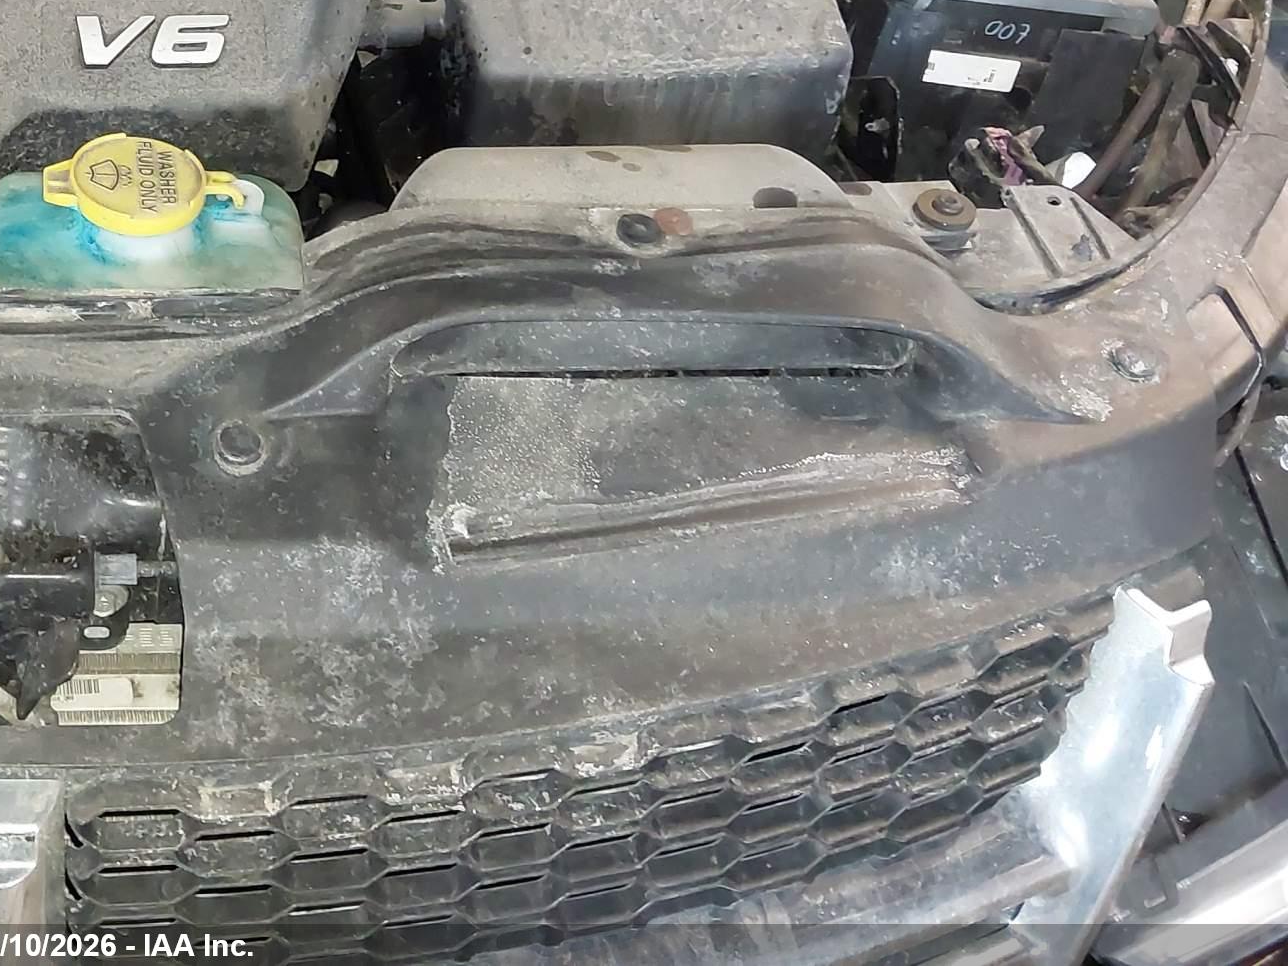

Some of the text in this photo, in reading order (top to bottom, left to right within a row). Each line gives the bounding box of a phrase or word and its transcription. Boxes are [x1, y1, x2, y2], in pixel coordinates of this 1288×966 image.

[75, 13, 230, 69] V6
[984, 20, 1031, 44] 007
[136, 141, 158, 213] FLUID ONLY
[156, 150, 177, 205] WASHER
